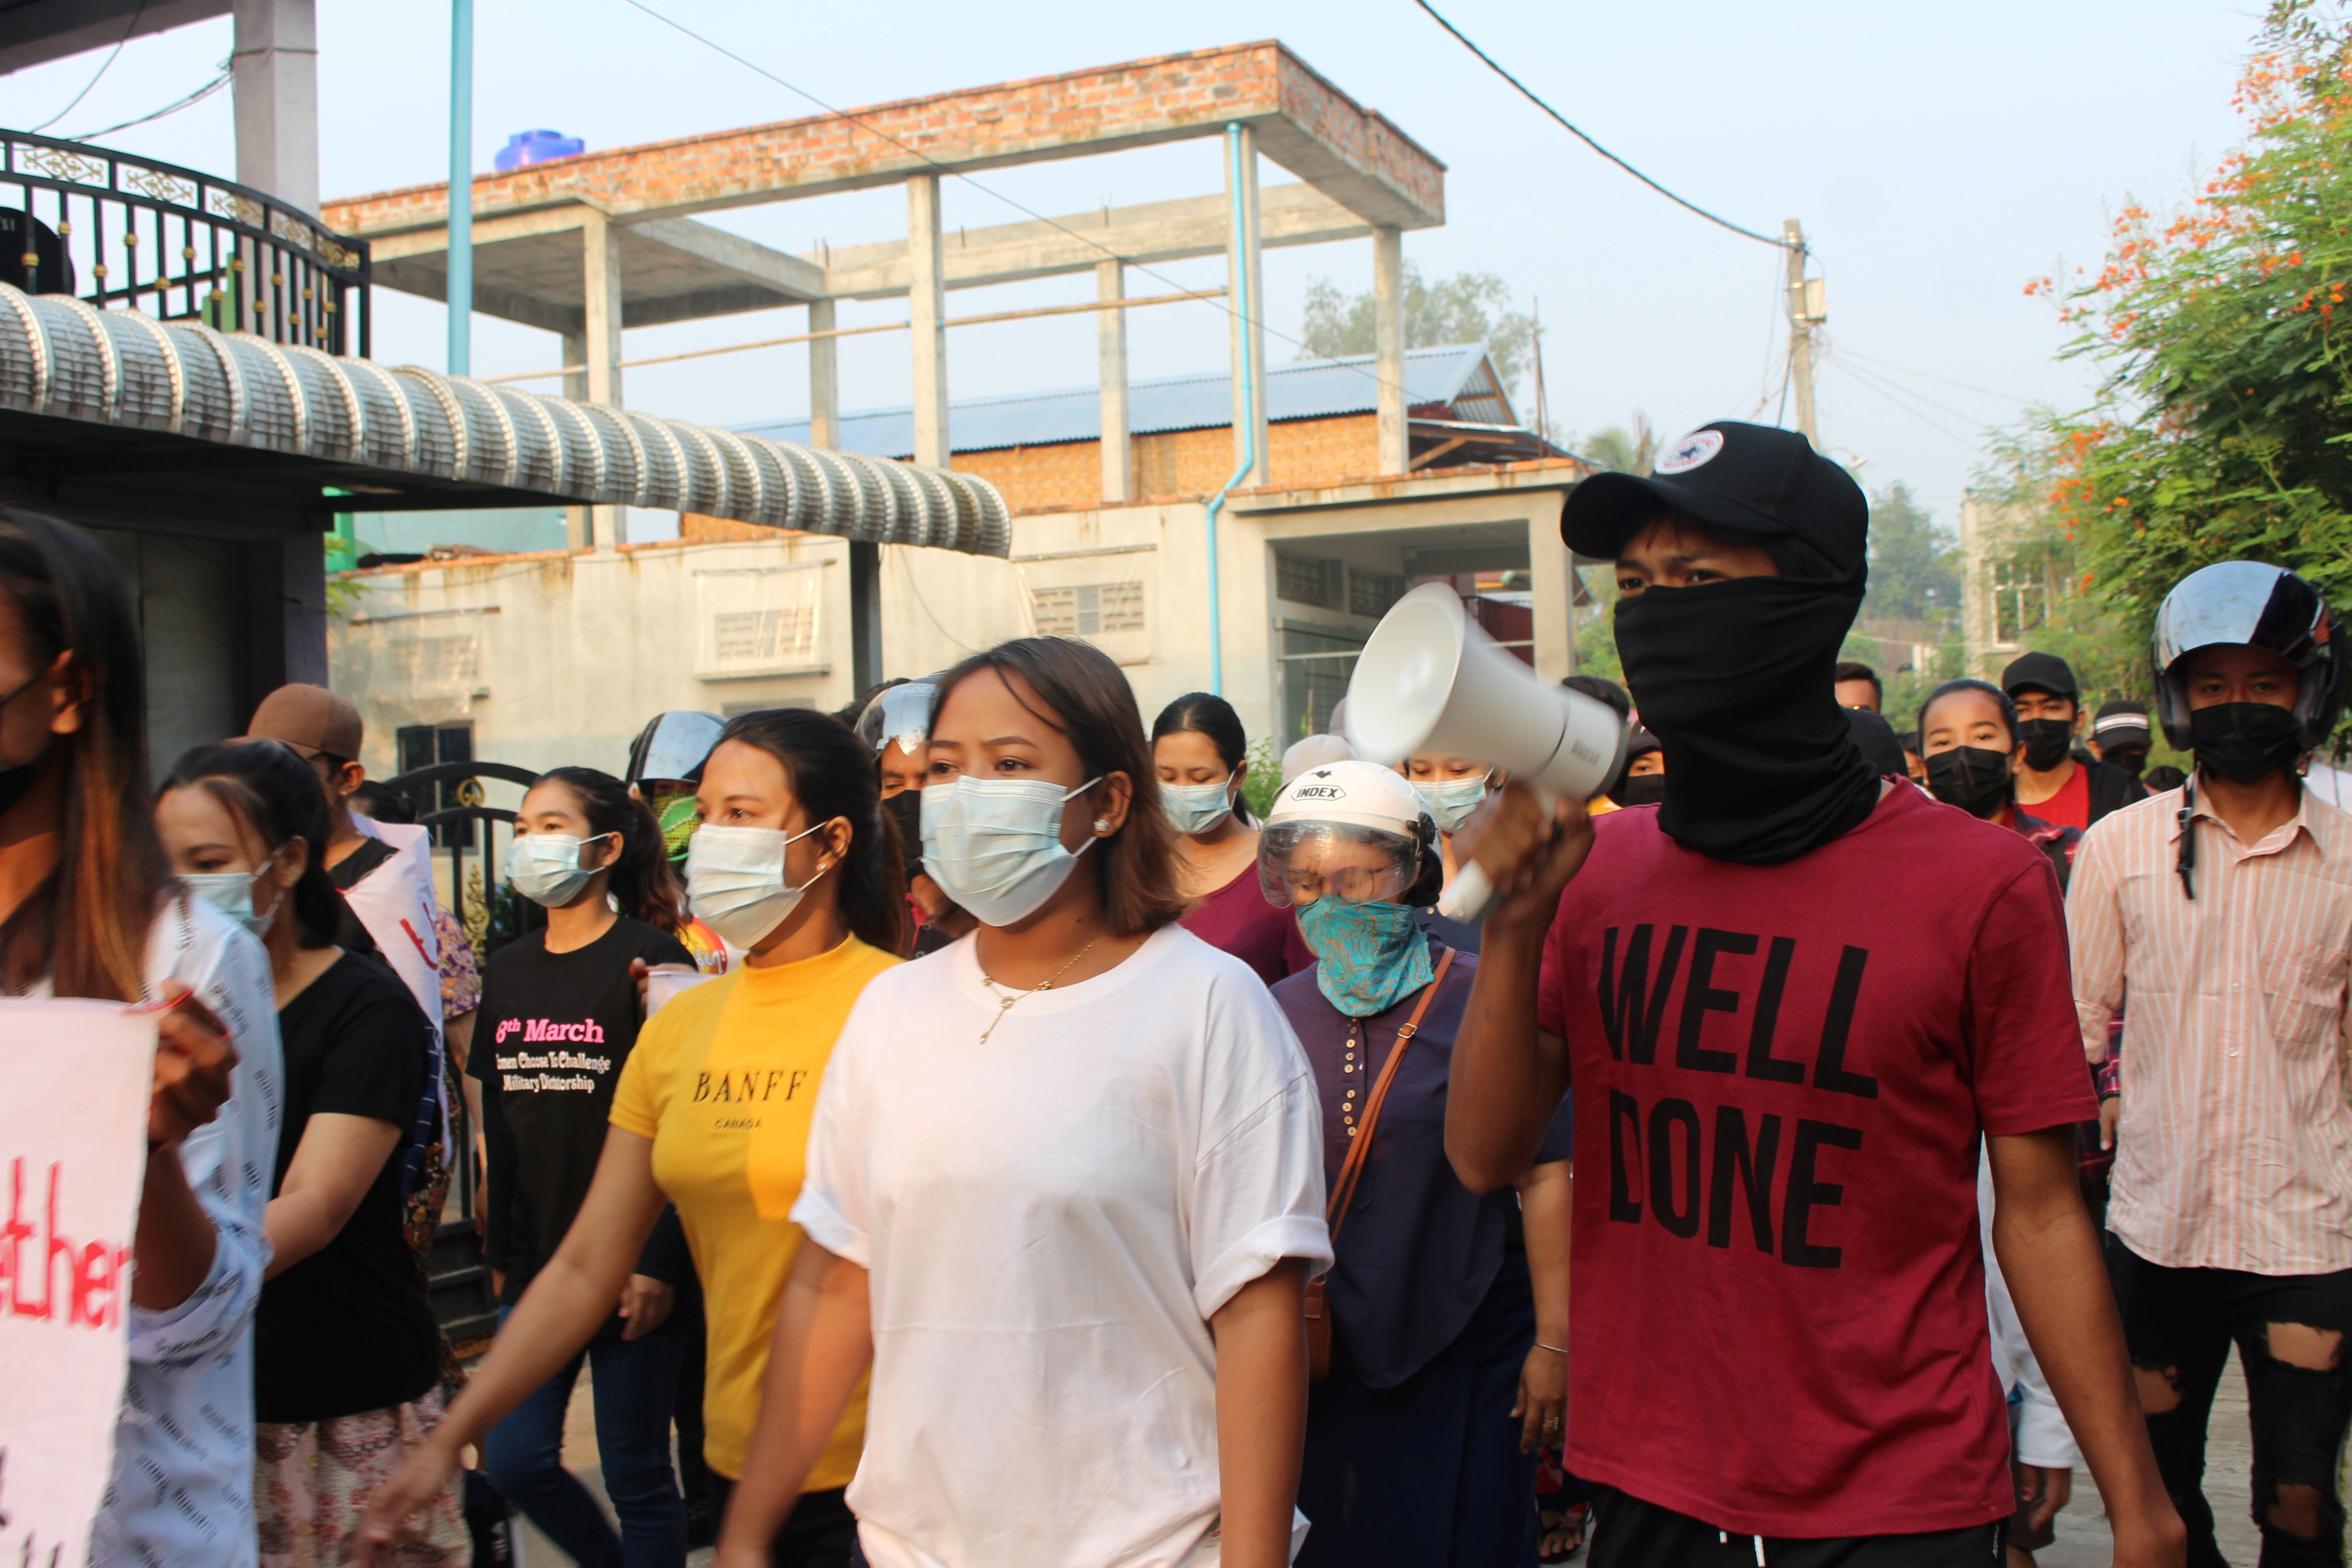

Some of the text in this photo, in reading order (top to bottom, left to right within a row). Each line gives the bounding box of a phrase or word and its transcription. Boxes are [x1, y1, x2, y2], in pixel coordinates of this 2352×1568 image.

[1296, 788, 1339, 798] INDEX
[1598, 924, 1878, 1099] WELL
[496, 1018, 604, 1043] 8th March
[558, 1051, 611, 1074] Challenge
[503, 1073, 595, 1093] Military Dictatorship
[692, 1070, 809, 1102] BANFF
[1610, 1089, 1863, 1269] DONE
